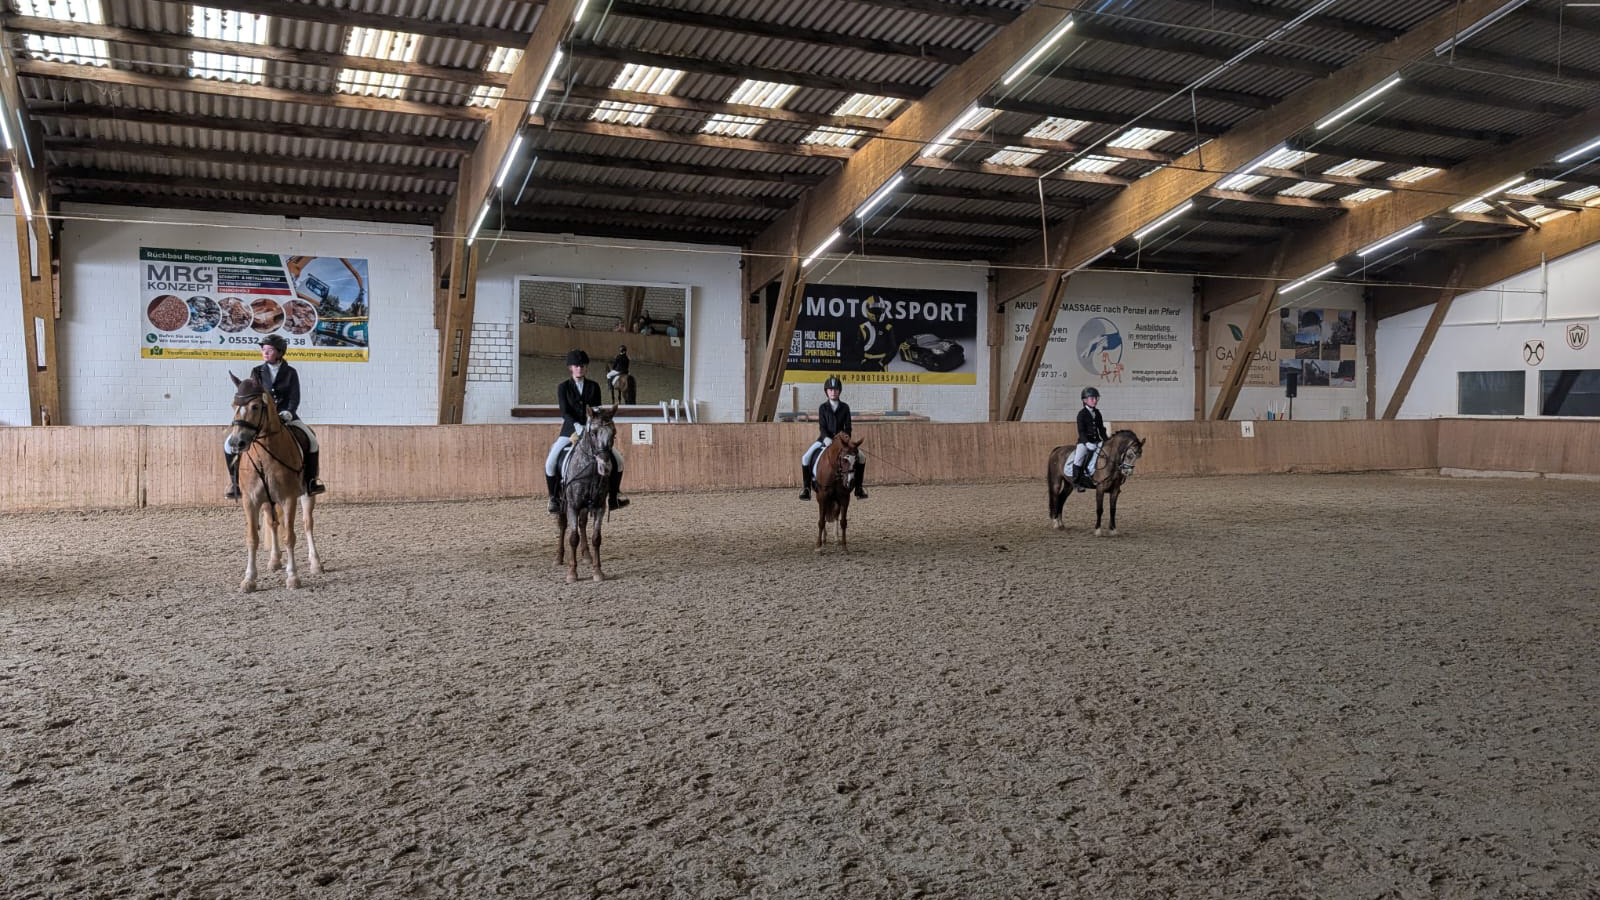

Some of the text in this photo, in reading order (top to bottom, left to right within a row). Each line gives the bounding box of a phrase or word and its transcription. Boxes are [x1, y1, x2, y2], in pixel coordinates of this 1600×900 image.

[147, 251, 182, 260] Rückbau
[184, 253, 222, 263] Recycling
[239, 256, 267, 264] System
[147, 264, 213, 283] MRG
[147, 282, 213, 292] KONZEPT
[1103, 305, 1121, 314] nach
[1123, 306, 1147, 315] Penzel
[1161, 308, 1182, 316] Pferd
[1015, 324, 1068, 335] 376 yen
[1135, 323, 1171, 333] Ausbildung
[804, 330, 836, 341] HOL MEHR
[1136, 333, 1177, 342] energetischer
[228, 336, 260, 344] 05532
[293, 338, 306, 346] 38
[805, 340, 836, 349] AUS DEINEN
[1133, 342, 1172, 351] Pferdepflege
[286, 351, 363, 359] www.mrg-konzept.de
[639, 430, 647, 440] E
